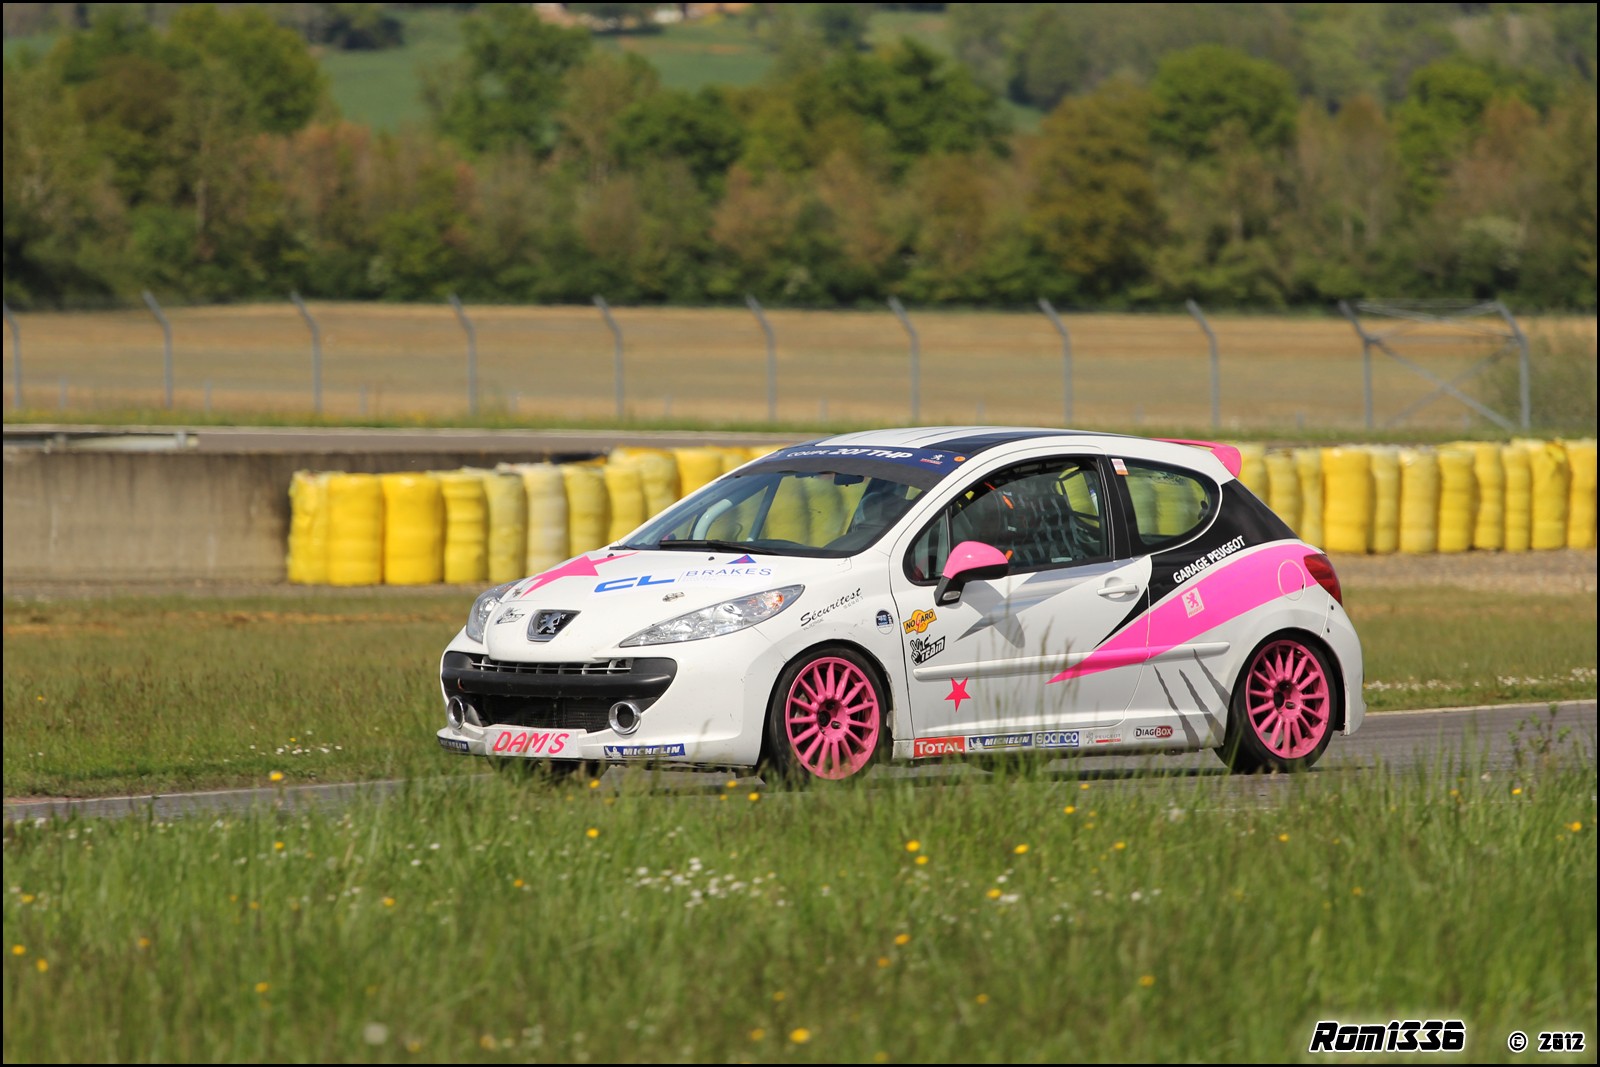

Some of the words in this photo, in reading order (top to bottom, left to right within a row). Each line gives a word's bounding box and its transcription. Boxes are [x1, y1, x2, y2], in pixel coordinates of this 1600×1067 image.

[866, 450, 913, 458] THP
[1173, 557, 1210, 584] GARAGE
[1207, 535, 1246, 563] PEUGEOT
[594, 576, 675, 593] CL
[686, 568, 772, 577] BRAKES
[800, 588, 862, 627] Sécuritest
[492, 731, 570, 754] DAM'S
[984, 735, 1030, 746] MICHELIN
[1036, 732, 1078, 746] sparco
[622, 746, 681, 756] MICHELIN
[916, 740, 963, 754] TOTAL
